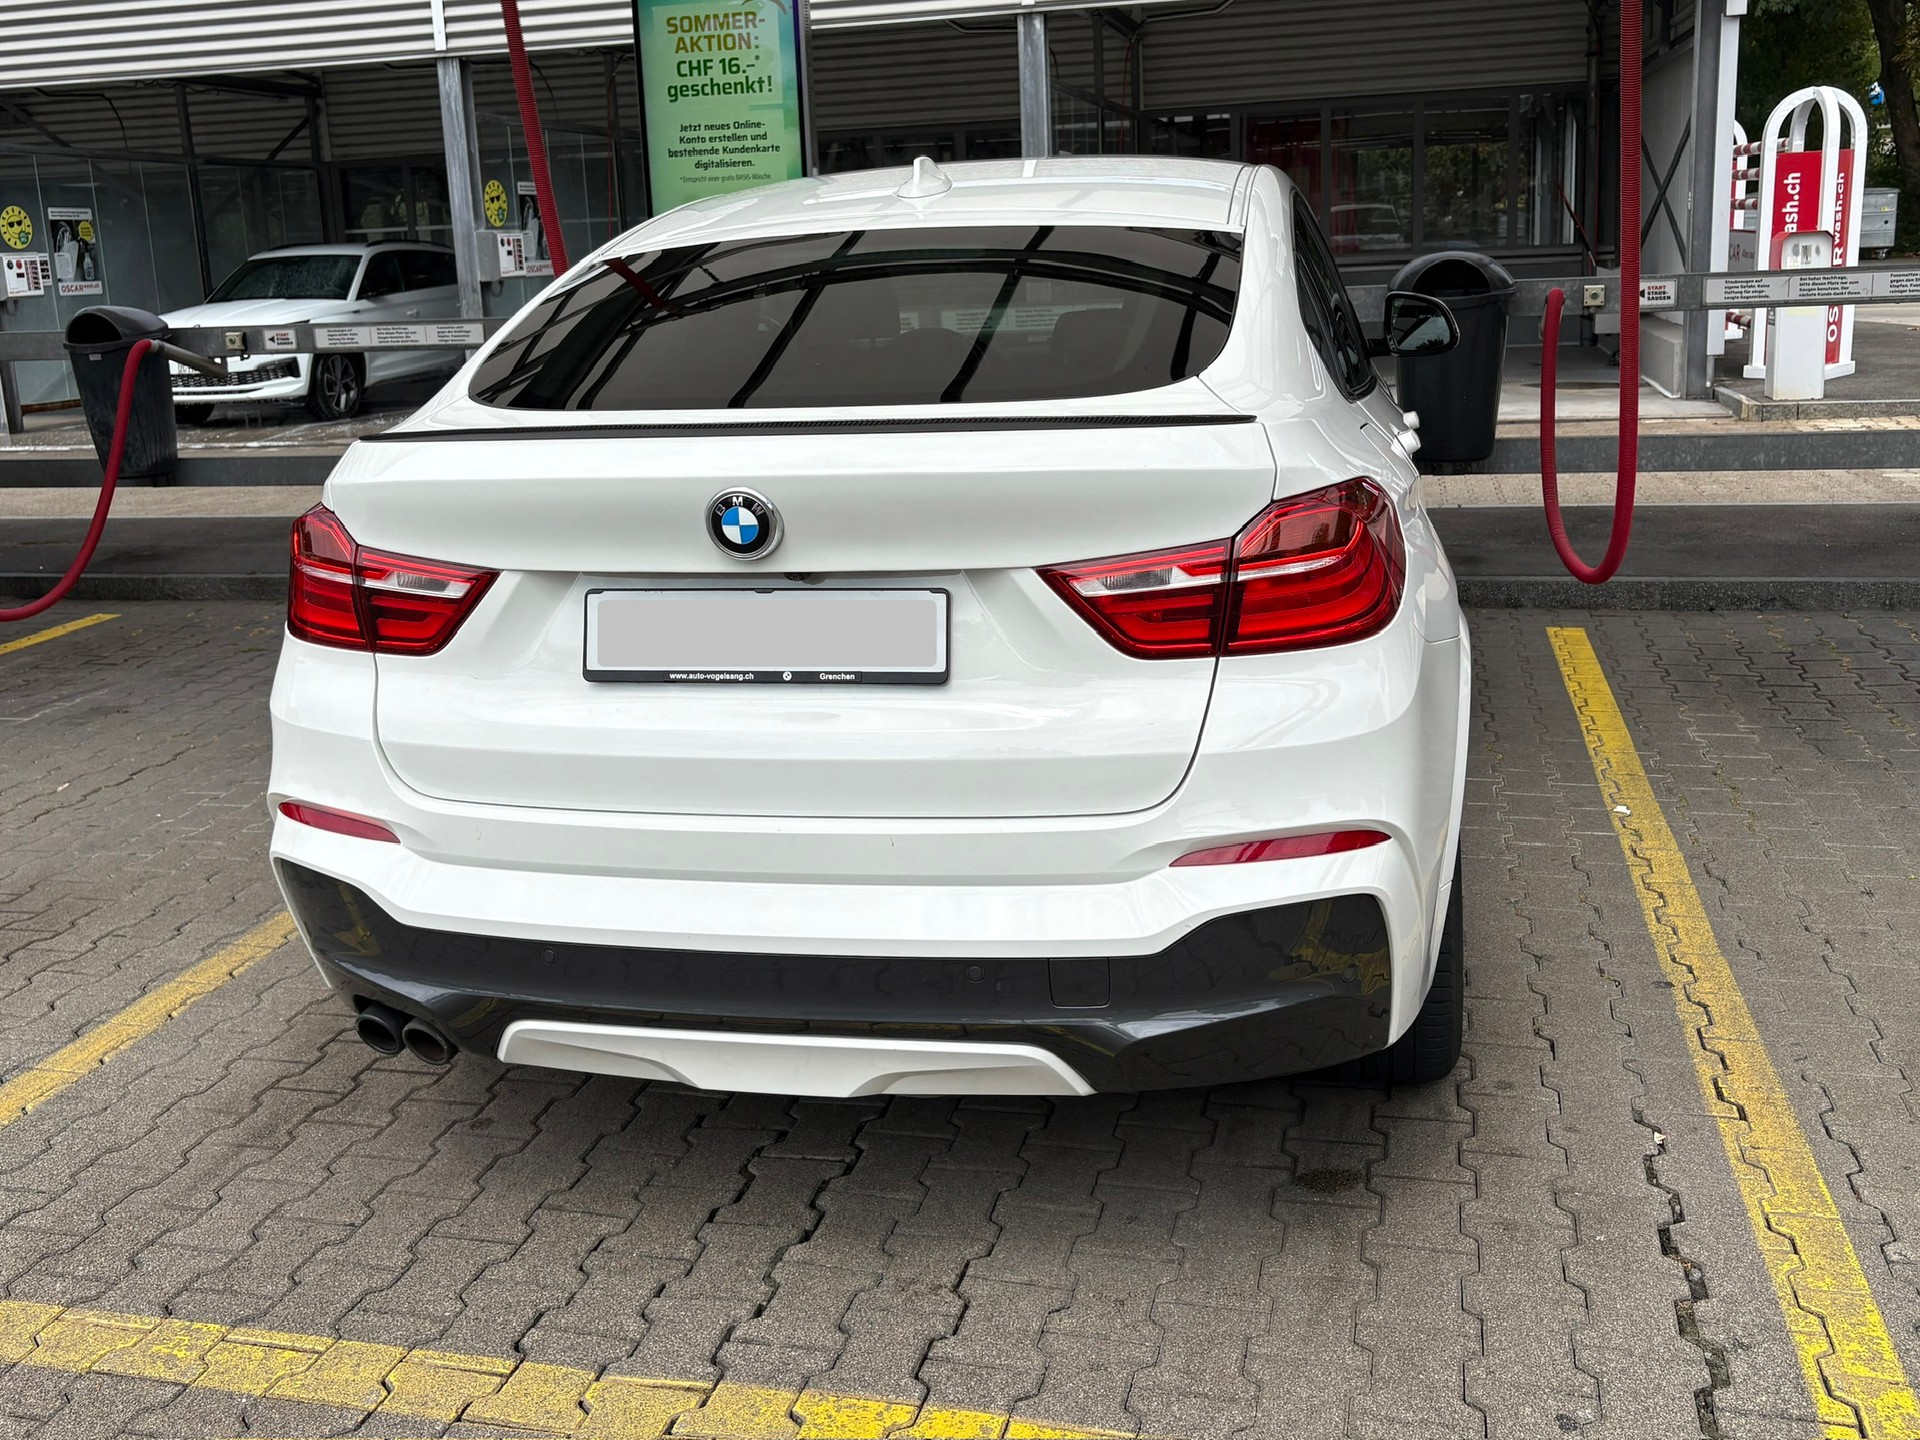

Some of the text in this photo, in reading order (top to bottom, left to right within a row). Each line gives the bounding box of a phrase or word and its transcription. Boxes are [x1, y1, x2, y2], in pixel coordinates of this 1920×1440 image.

[666, 11, 765, 34] SOMMER-
[675, 32, 759, 54] AKTION:
[676, 58, 714, 78] CHF
[667, 75, 773, 103] geschenkt!
[680, 120, 766, 132] Jetzt neues Online-
[679, 131, 768, 145] Konto erstellen und
[668, 144, 781, 158] bestehende Kundenkarte
[694, 159, 756, 171] digitalisieren.
[714, 496, 765, 516] BMW
[669, 671, 856, 681] www.auto-vogelsang.ch Grenchen
